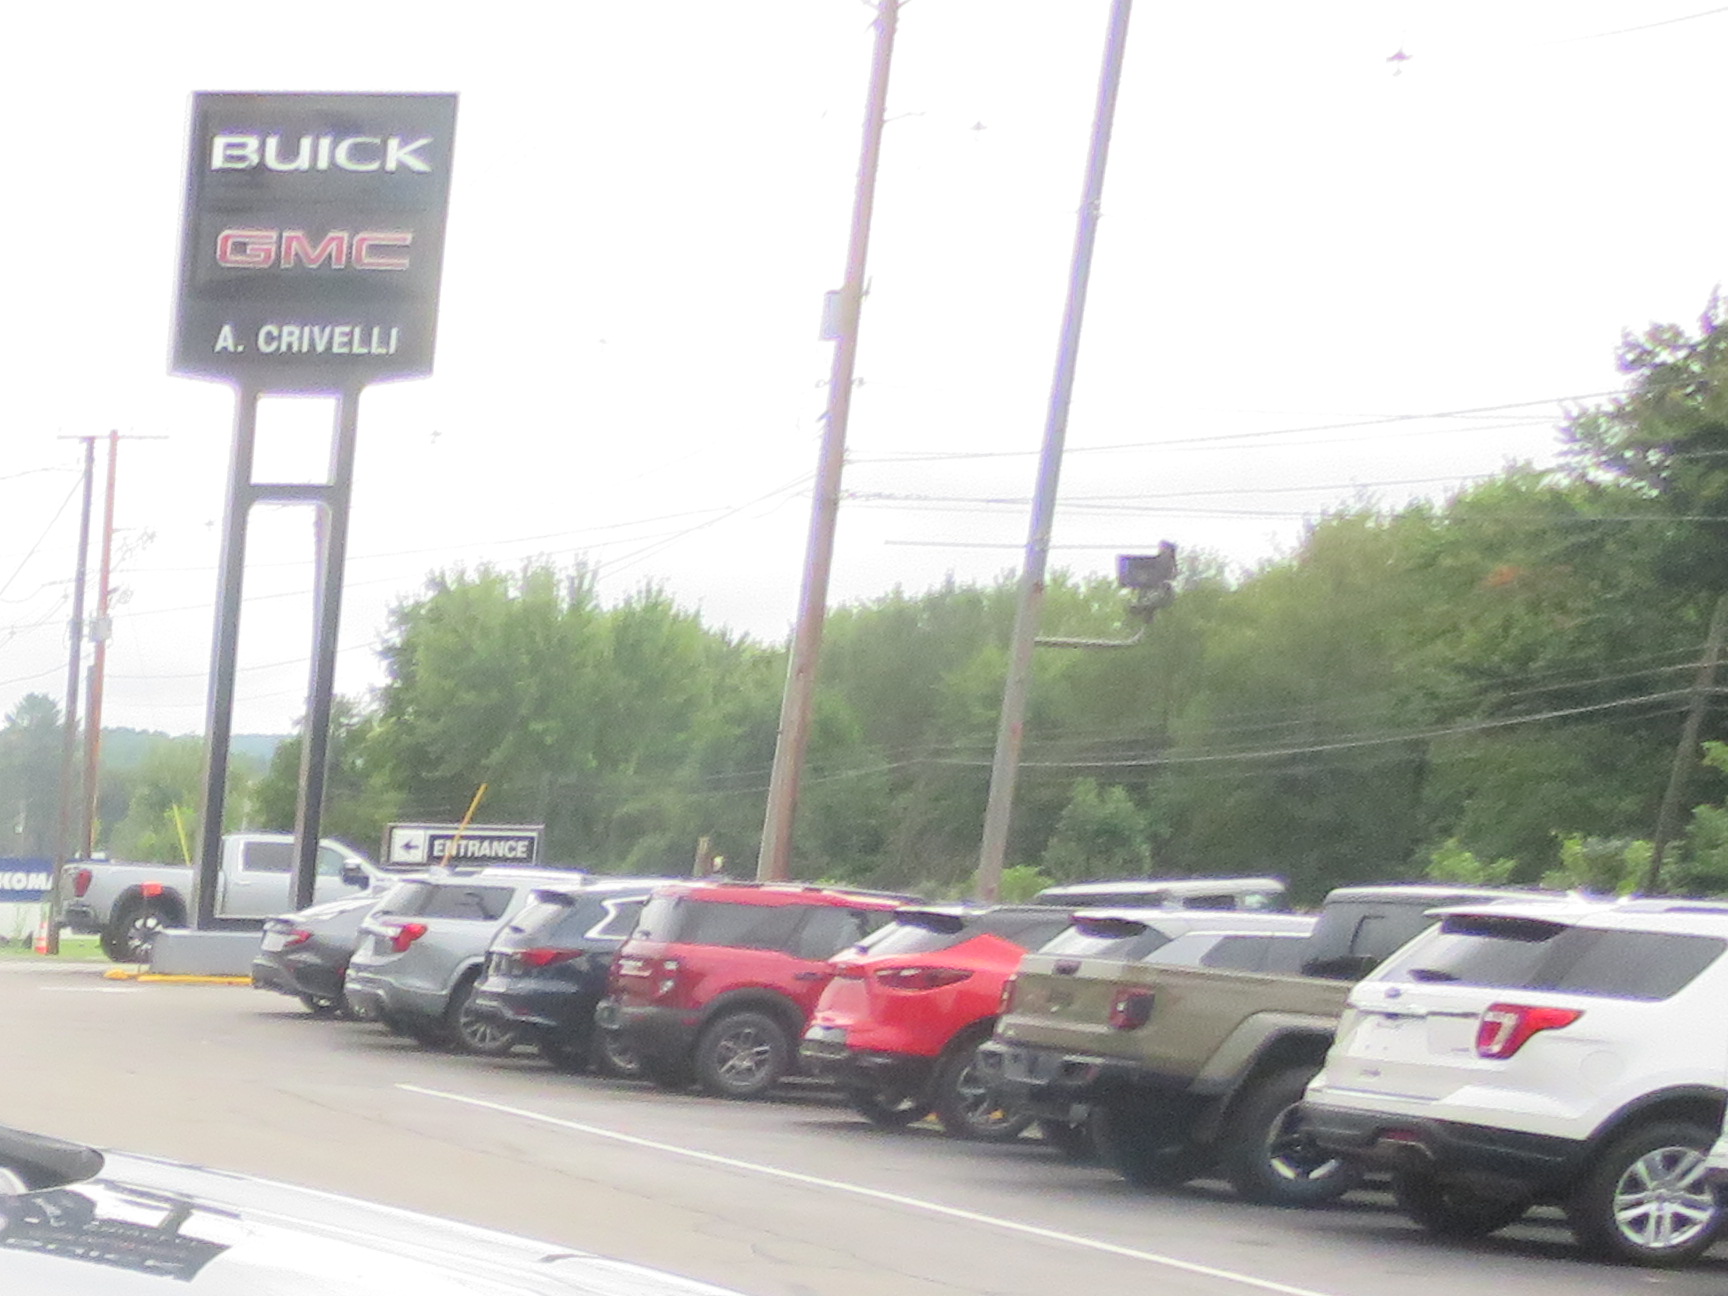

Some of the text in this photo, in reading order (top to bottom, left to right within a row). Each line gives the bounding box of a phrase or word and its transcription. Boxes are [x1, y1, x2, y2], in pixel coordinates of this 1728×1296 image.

[211, 134, 434, 172] BUICK
[216, 229, 413, 270] GMC
[214, 324, 399, 354] A. CRIVELLI
[433, 839, 529, 858] ENTRANCE
